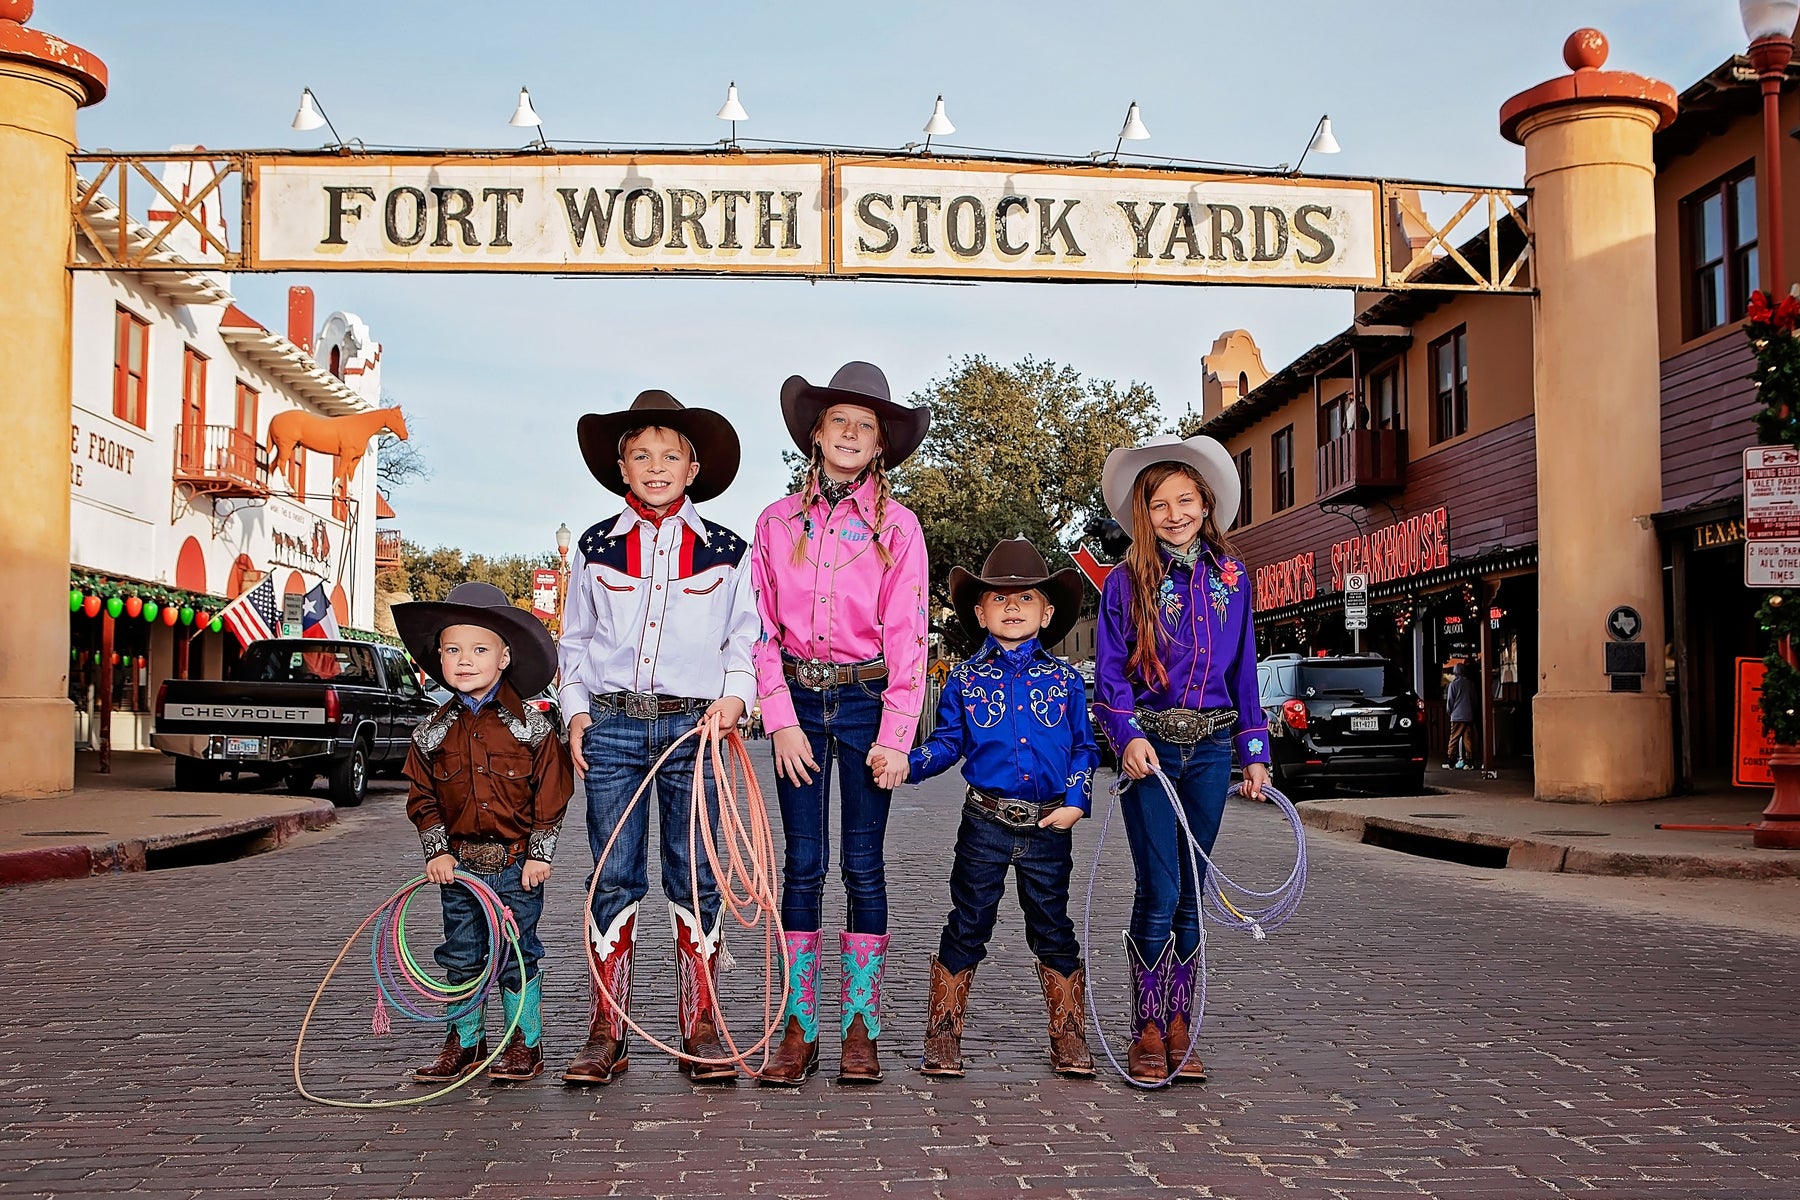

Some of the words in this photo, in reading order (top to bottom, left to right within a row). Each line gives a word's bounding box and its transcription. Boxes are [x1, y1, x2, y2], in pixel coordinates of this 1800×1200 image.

[320, 186, 524, 248] FORT
[556, 187, 802, 249] WORTH
[857, 192, 1087, 257] STOCK
[1116, 200, 1336, 264] YARDS
[88, 432, 134, 475] FRONT
[1748, 469, 1776, 479] TOWING
[1752, 479, 1774, 488] VALET
[1331, 506, 1450, 592] STEAKHOUSE
[1750, 547, 1755, 556] 2
[1758, 546, 1780, 556] HOUR
[1770, 571, 1794, 580] TIMES
[284, 625, 289, 635] 2
[1443, 623, 1464, 635] SALOON
[181, 706, 310, 721] CHEVROLET
